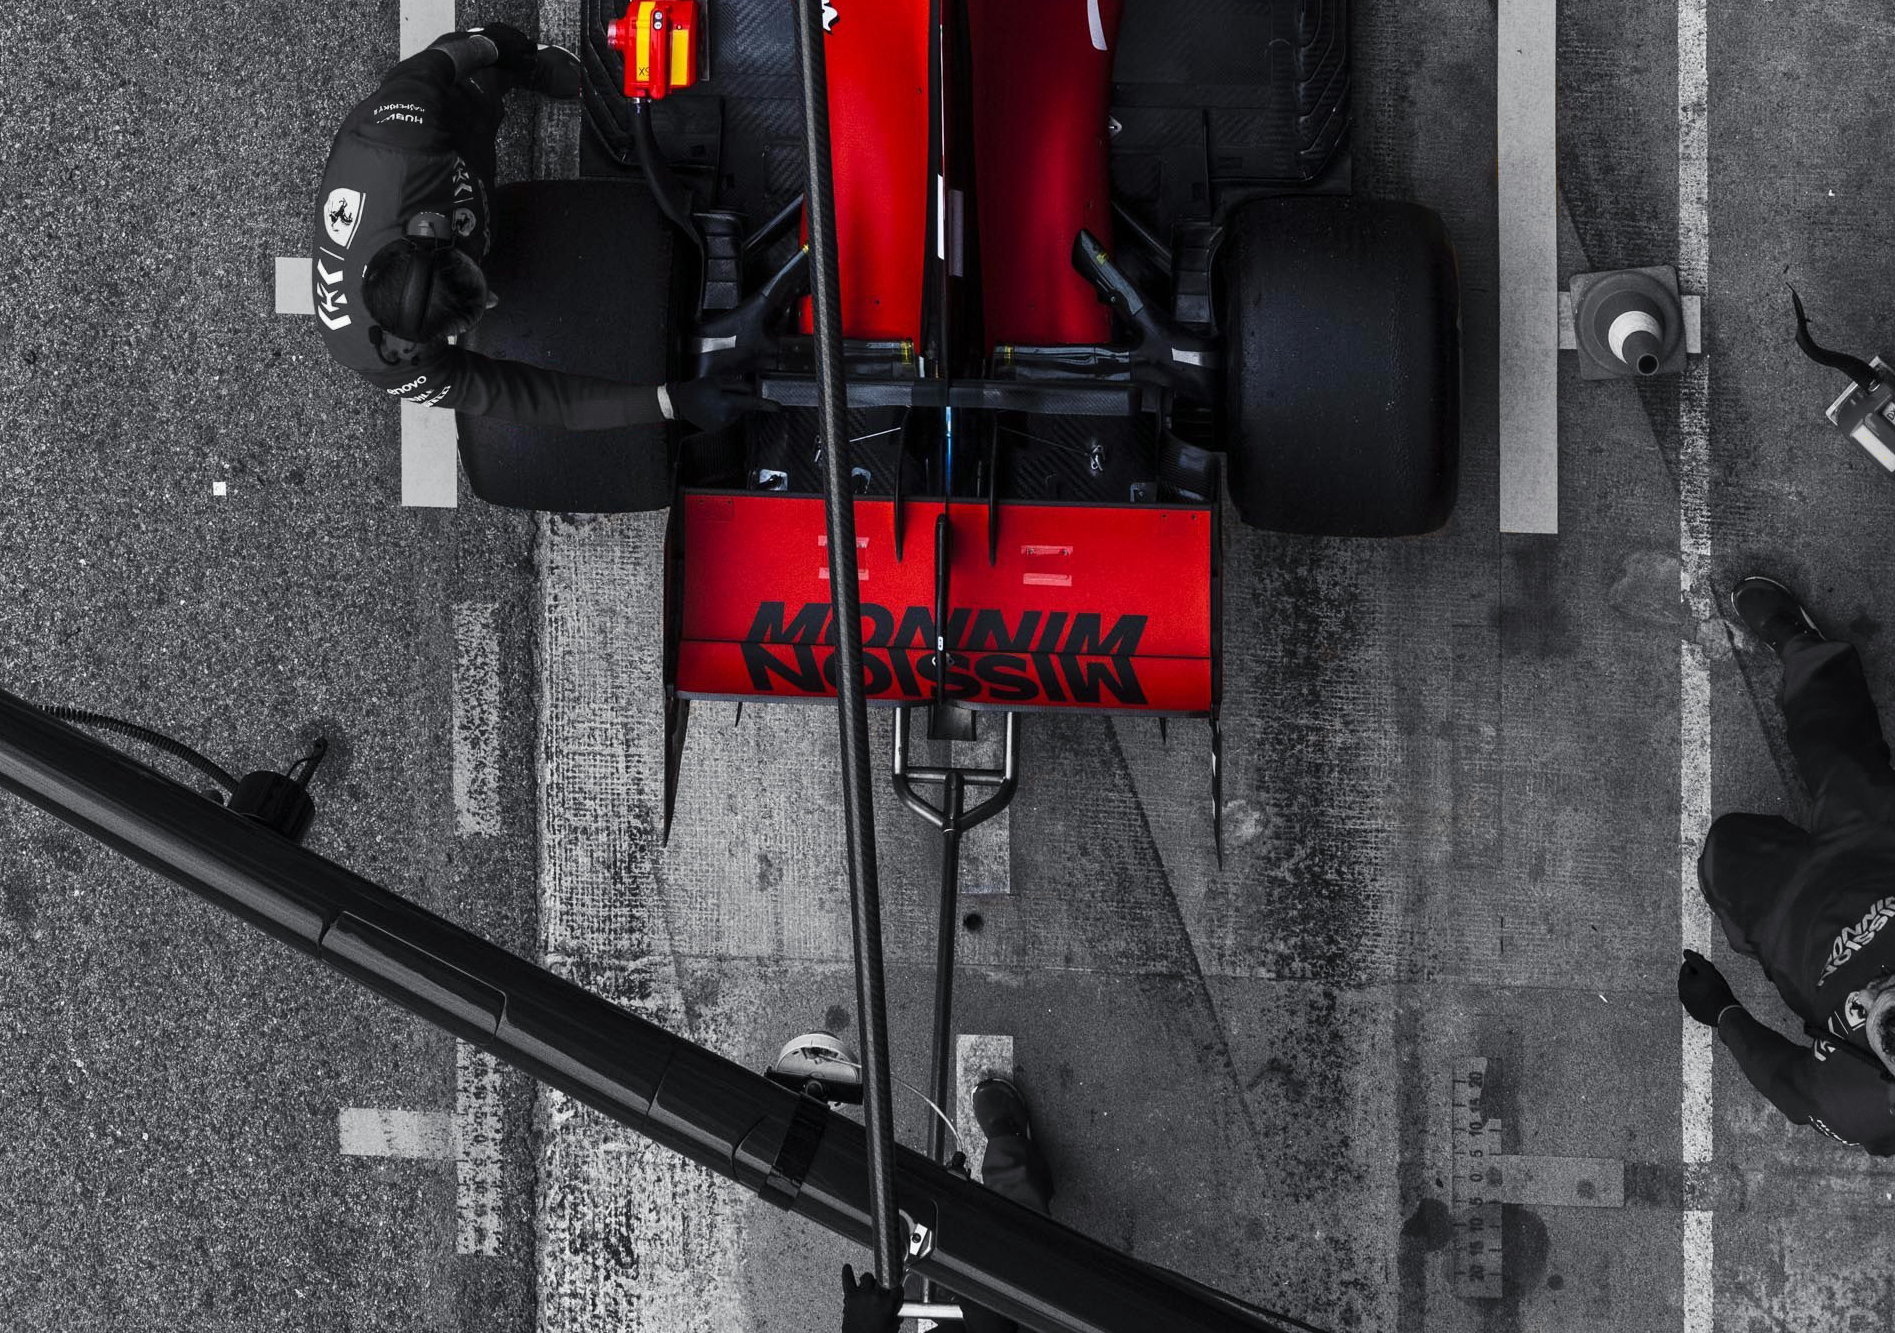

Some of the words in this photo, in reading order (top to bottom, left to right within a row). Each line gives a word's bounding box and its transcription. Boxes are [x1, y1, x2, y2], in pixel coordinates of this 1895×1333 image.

[743, 601, 1149, 655] WINNOW
[739, 642, 1149, 705] MISSION
[1468, 1121, 1483, 1134] 10
[1468, 1148, 1484, 1159] 5
[1469, 1173, 1483, 1183] 0
